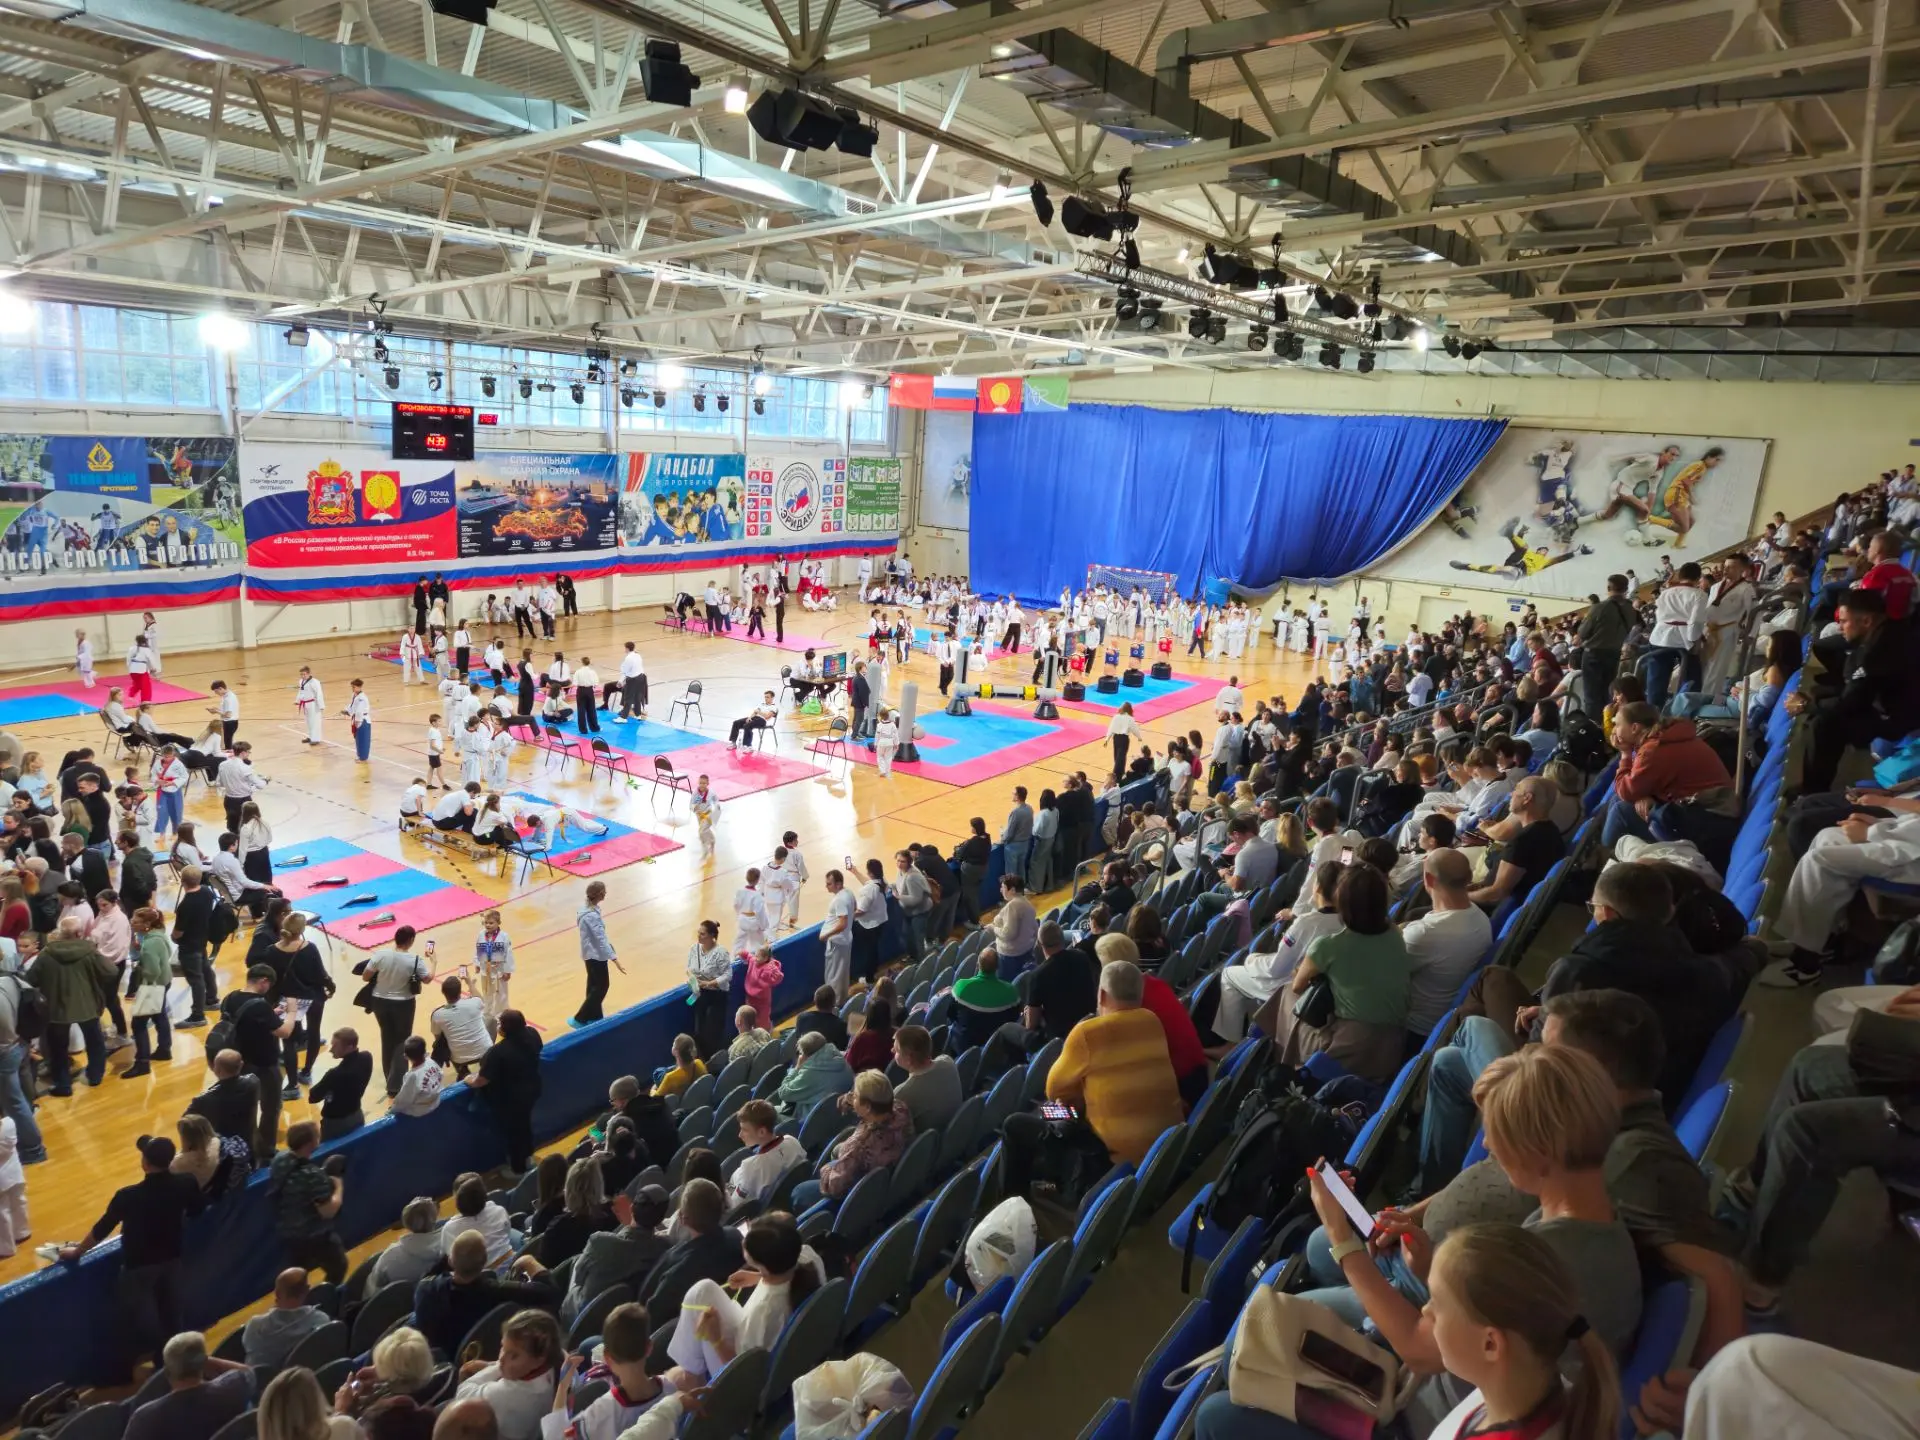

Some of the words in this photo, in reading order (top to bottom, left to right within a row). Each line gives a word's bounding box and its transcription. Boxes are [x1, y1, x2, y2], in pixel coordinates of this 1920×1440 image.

[399, 404, 447, 413] ПРОИЗВОДСТВО
[510, 455, 572, 465] СПЕЦИАЛЬНАЯ
[656, 457, 714, 478] ГАНДБОЛ
[549, 467, 580, 476] ОХРАНА
[780, 509, 813, 530] ЭРИДАН
[63, 548, 131, 569] СПОРТА
[137, 546, 148, 565] В
[156, 542, 239, 563] ПРОТВИНО
